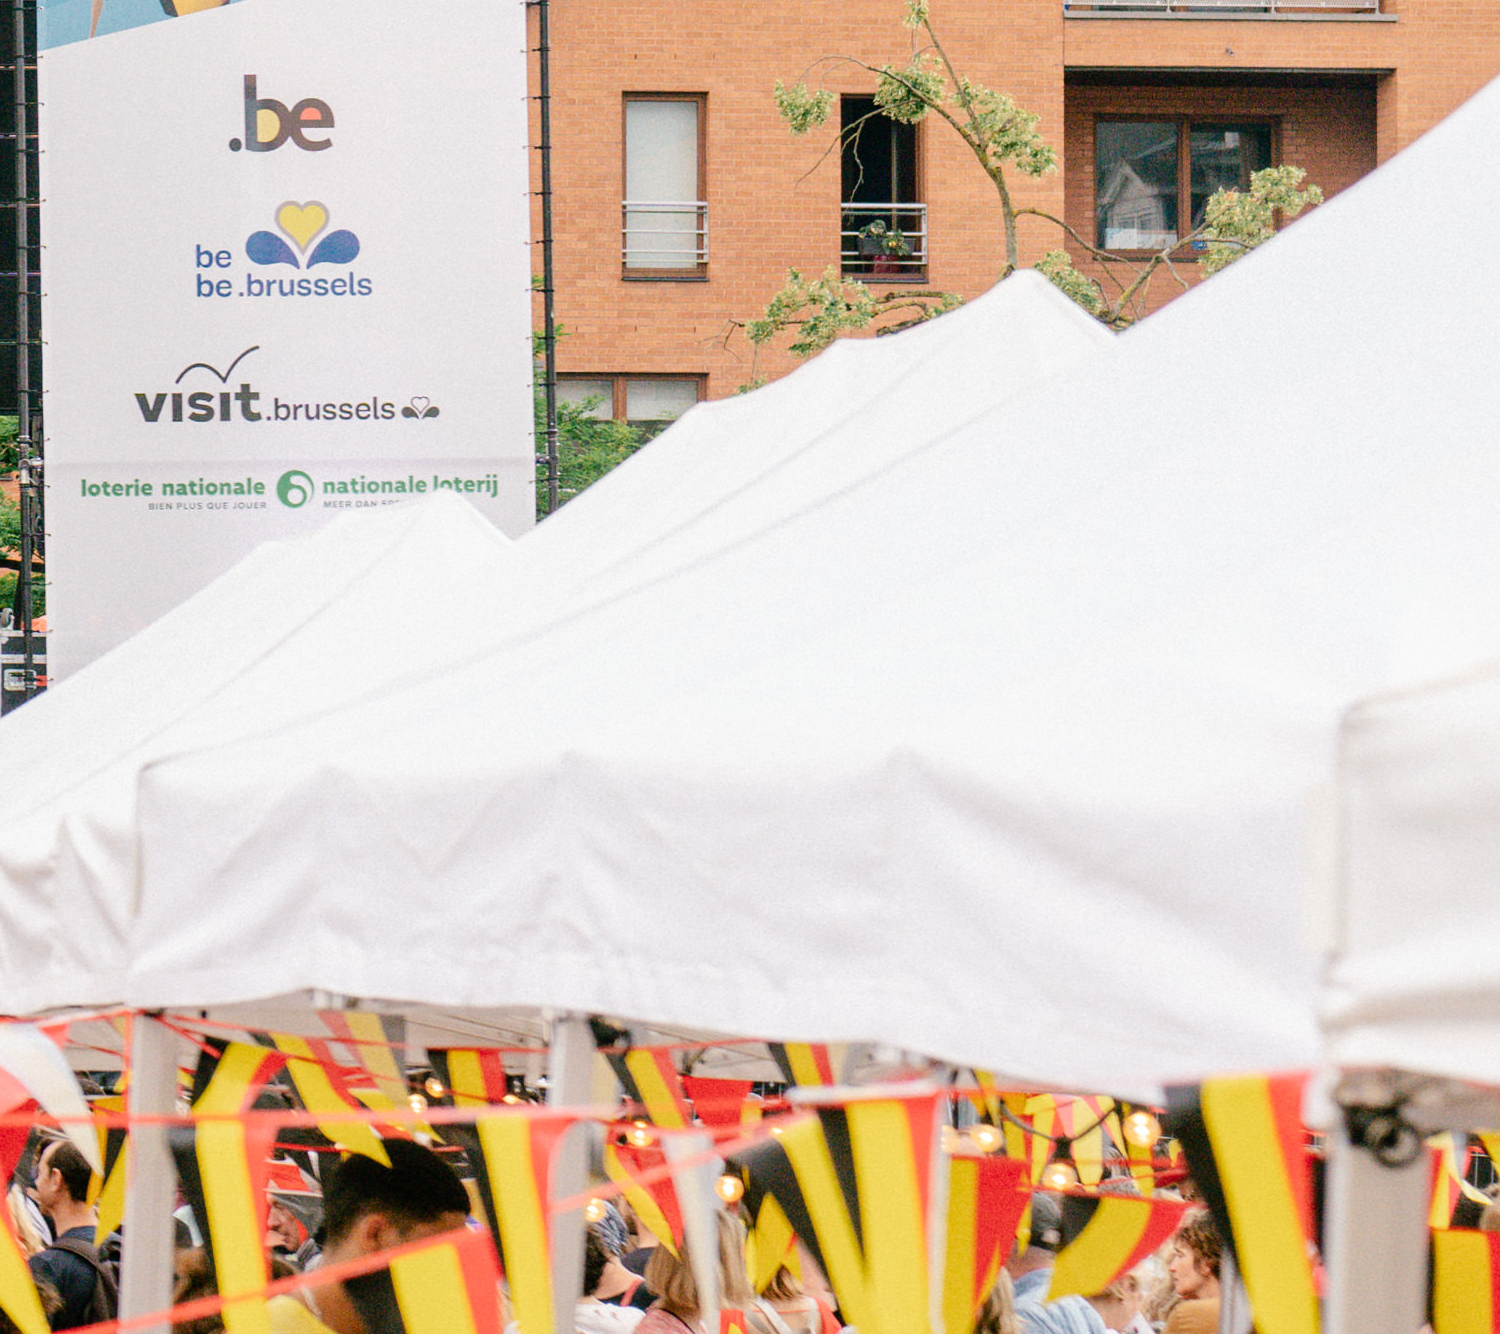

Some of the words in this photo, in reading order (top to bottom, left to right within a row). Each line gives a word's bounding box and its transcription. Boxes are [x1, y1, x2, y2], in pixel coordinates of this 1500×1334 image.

[228, 73, 337, 154] .be
[196, 244, 233, 269] be
[81, 478, 154, 498] loterie
[162, 477, 266, 497] nationale
[322, 475, 428, 495] nationale
[148, 502, 174, 512] BIEN
[176, 502, 204, 511] PLUS
[206, 501, 229, 511] QUE
[232, 501, 268, 511] JOUER
[323, 500, 352, 509] MEER
[355, 499, 378, 508] DAN
